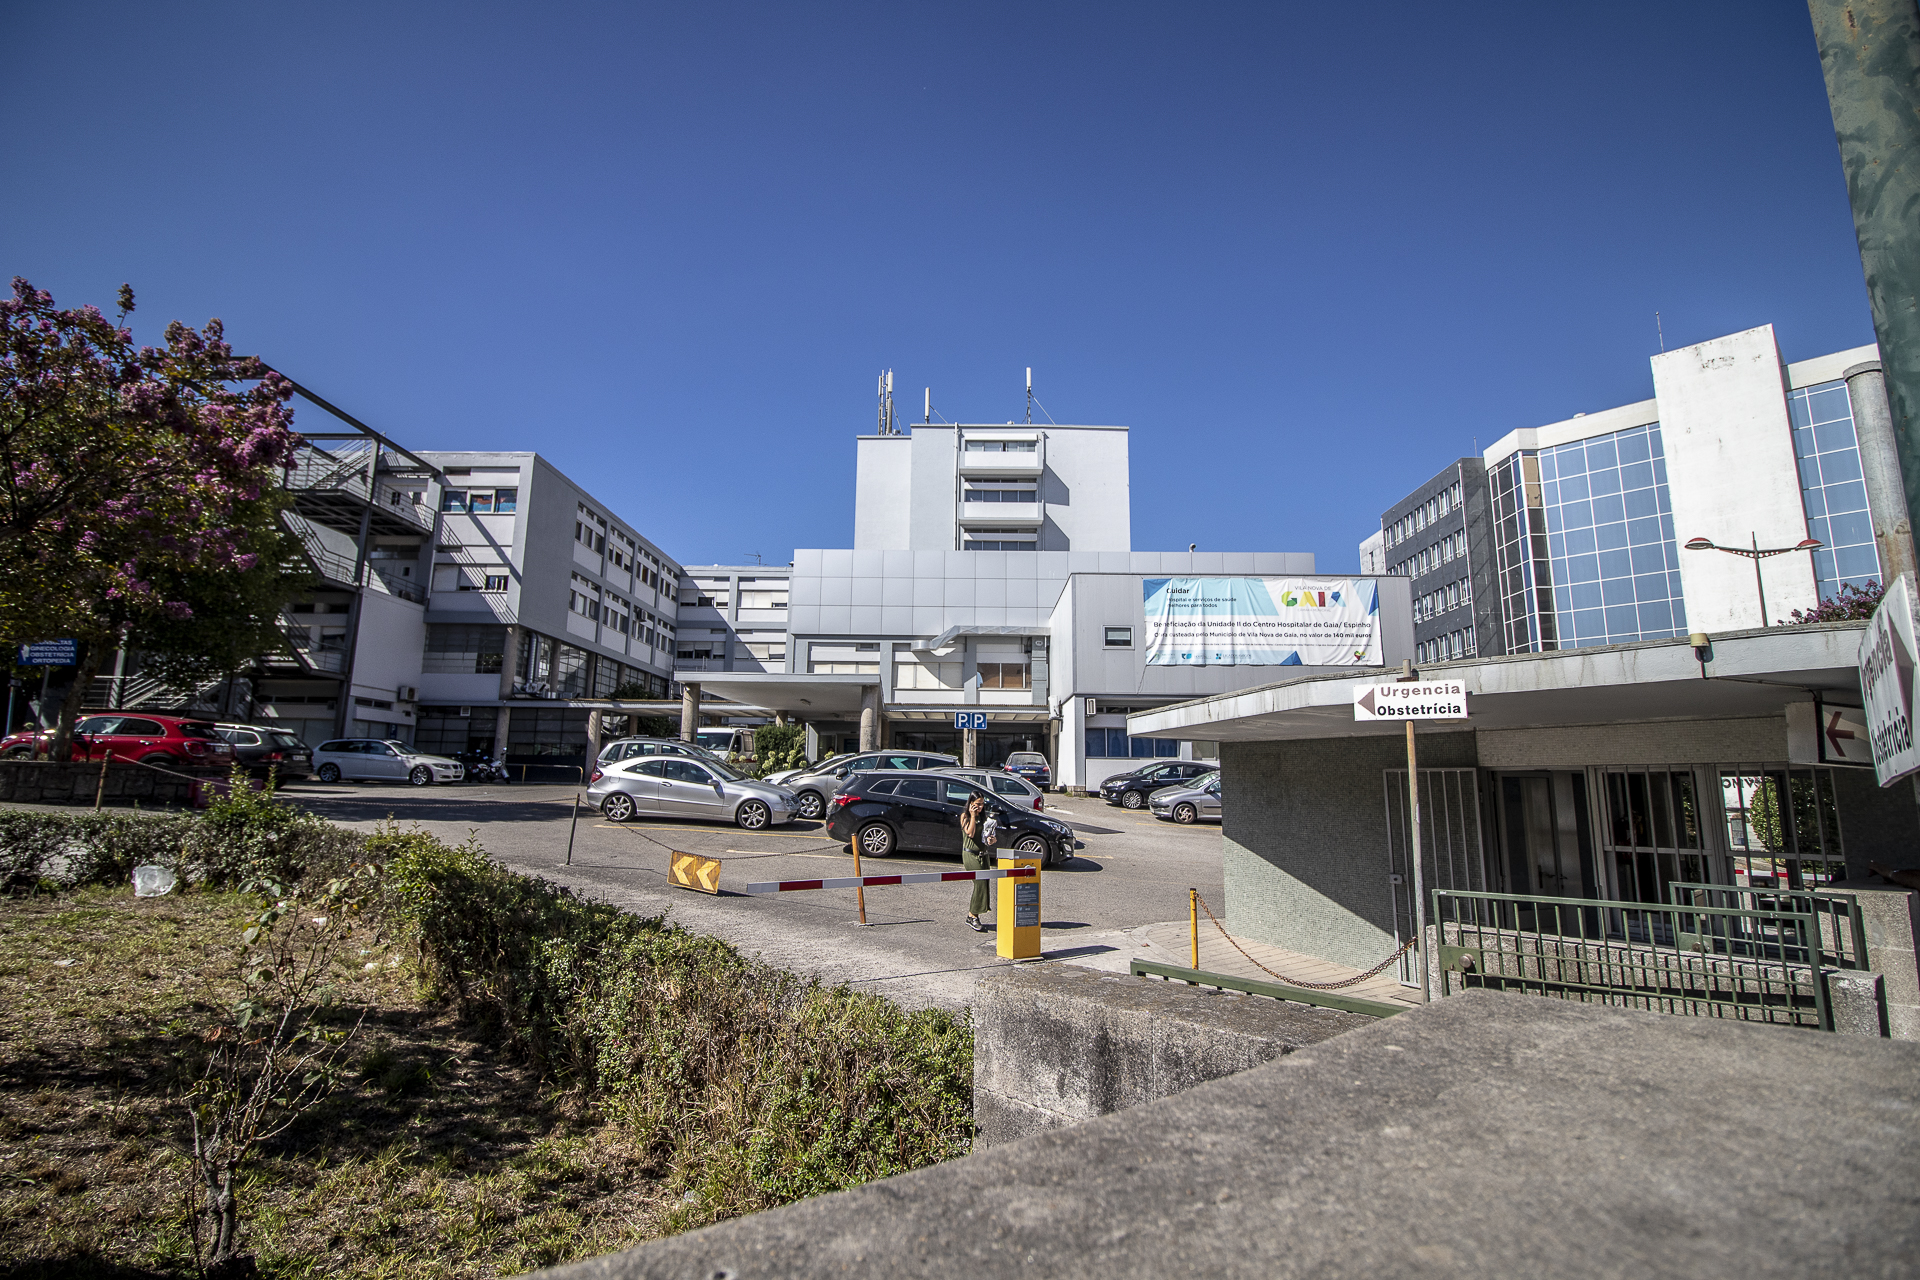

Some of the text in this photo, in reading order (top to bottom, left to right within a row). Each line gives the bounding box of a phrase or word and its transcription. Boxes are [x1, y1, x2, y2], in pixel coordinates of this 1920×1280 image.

[1281, 591, 1347, 607] GAIA
[1380, 683, 1461, 698] Urgencia
[1377, 703, 1461, 715] Obstetrícia
